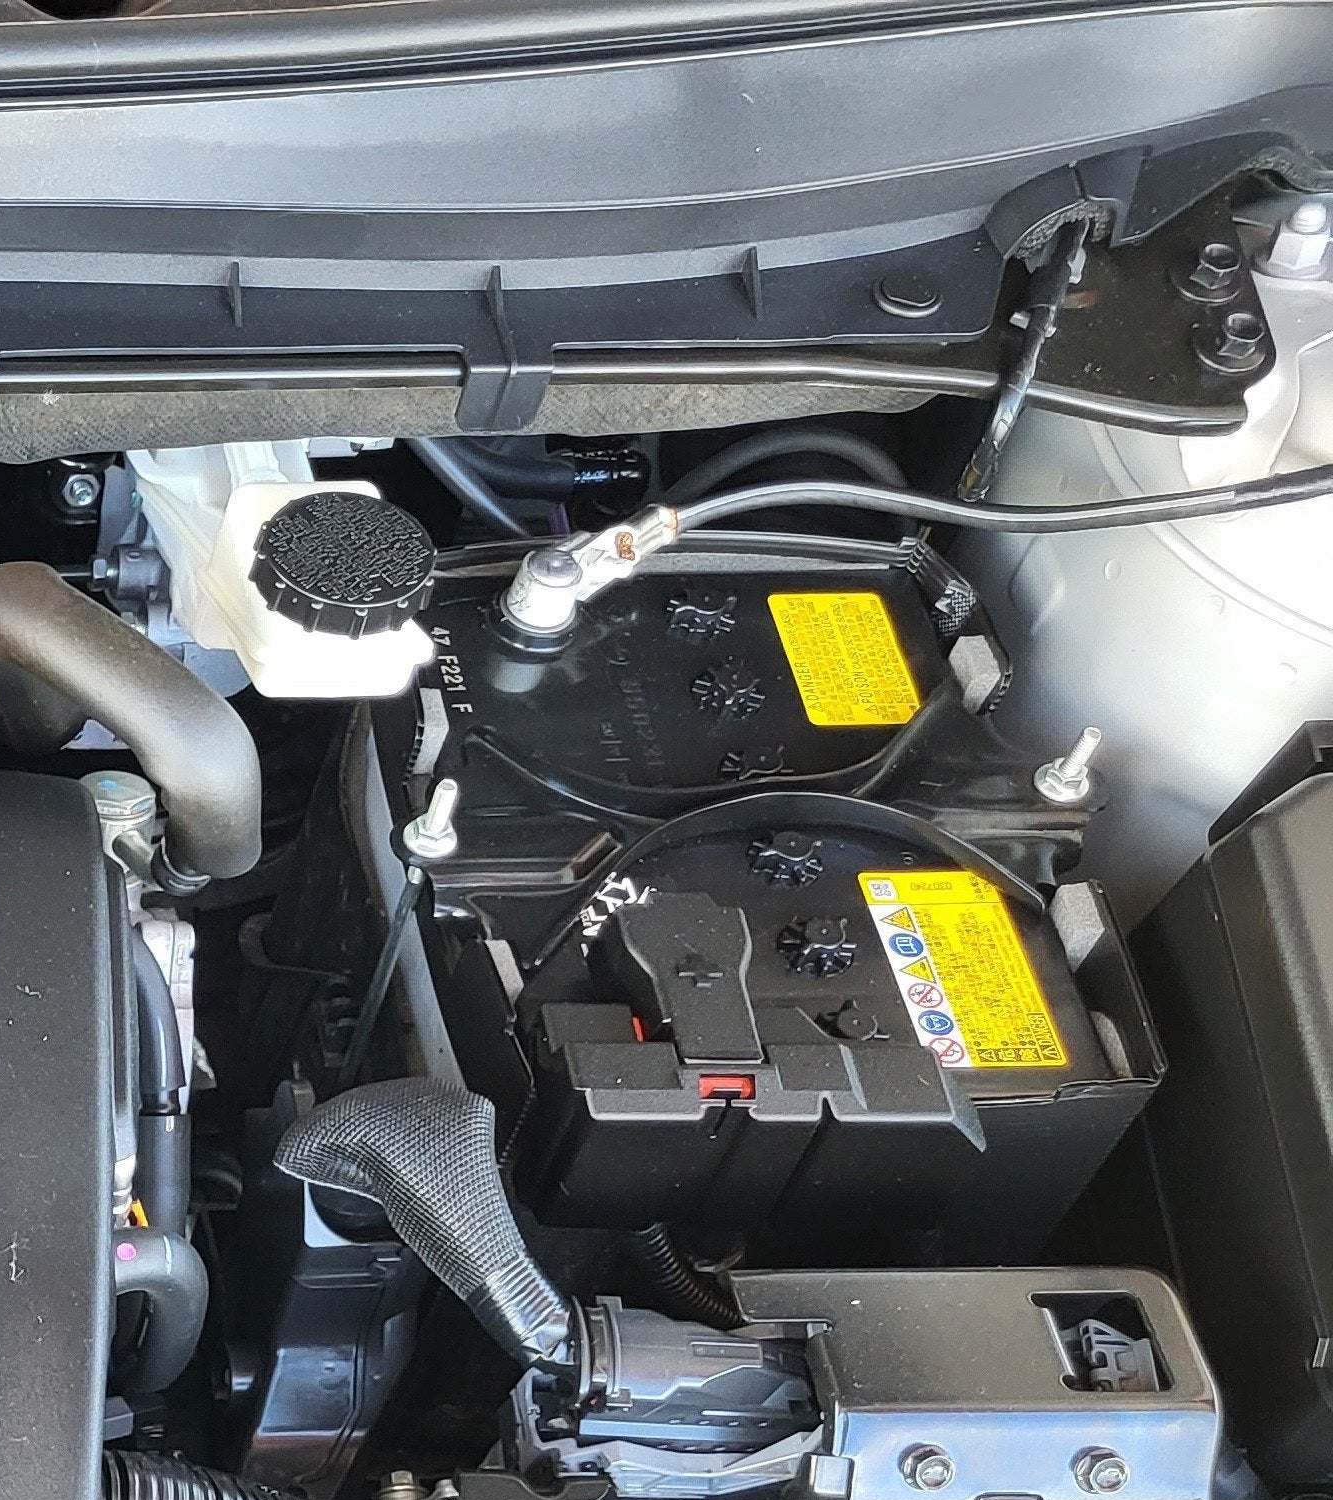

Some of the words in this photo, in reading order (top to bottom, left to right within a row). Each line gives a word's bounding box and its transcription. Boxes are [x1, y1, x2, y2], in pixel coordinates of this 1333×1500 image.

[431, 626, 452, 647] 47
[437, 655, 467, 692] F221
[794, 661, 820, 701] DANGER
[851, 671, 874, 704] POISON
[451, 703, 473, 713] F
[1032, 1013, 1057, 1050] DANGER
